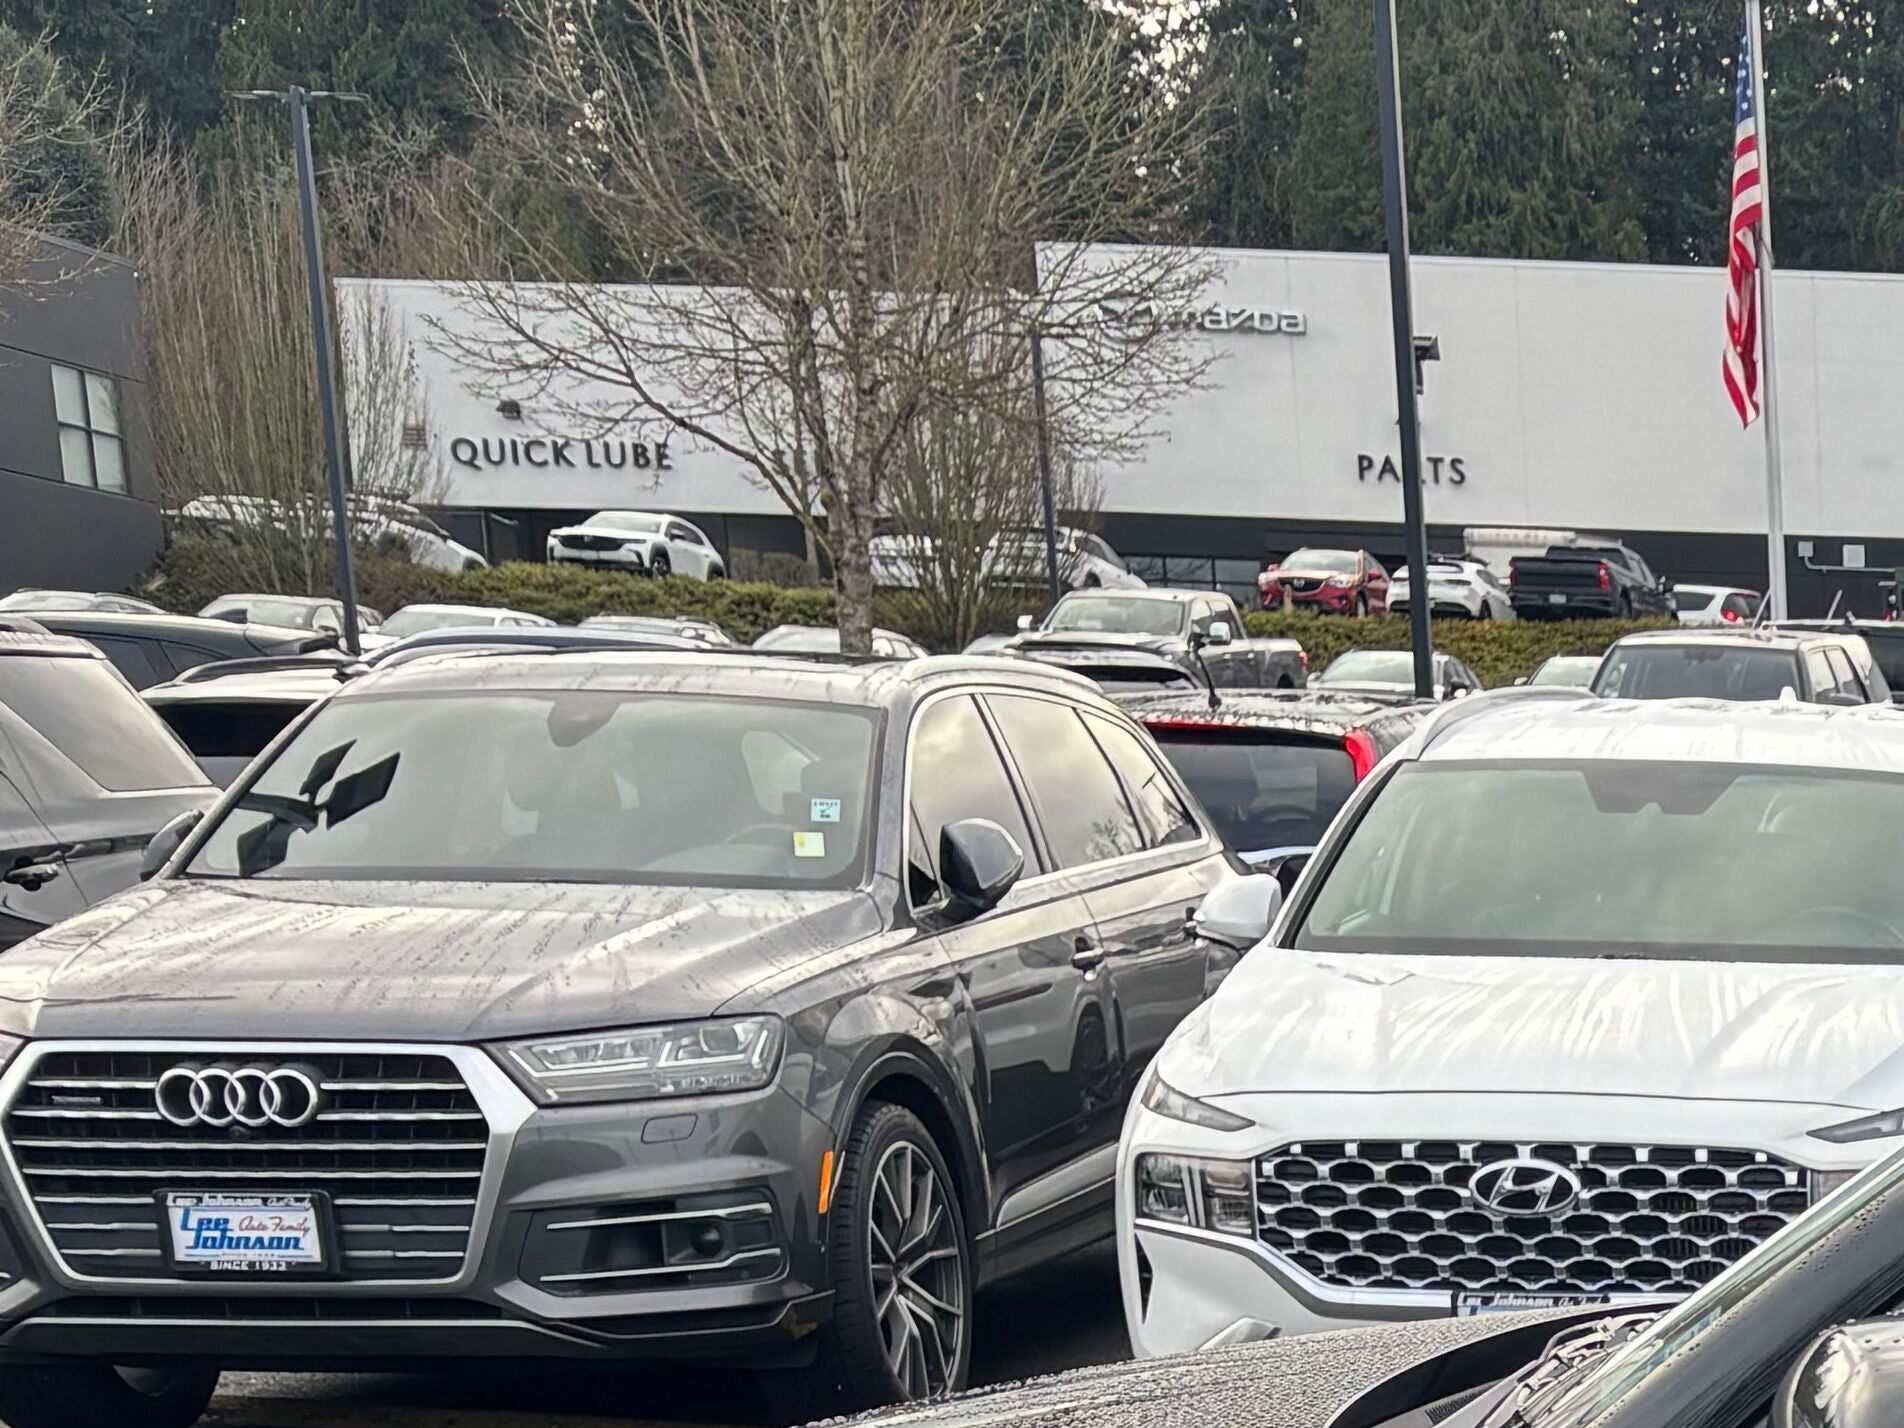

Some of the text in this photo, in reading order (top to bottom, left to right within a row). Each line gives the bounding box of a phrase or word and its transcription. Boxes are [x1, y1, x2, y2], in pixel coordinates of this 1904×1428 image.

[450, 436, 674, 472] QUICK LUBE
[1357, 453, 1467, 486] PATS
[180, 1207, 235, 1231] Lee
[238, 1215, 311, 1237] Auto Family
[185, 1231, 305, 1251] Johnson
[210, 1260, 249, 1271] SINCE
